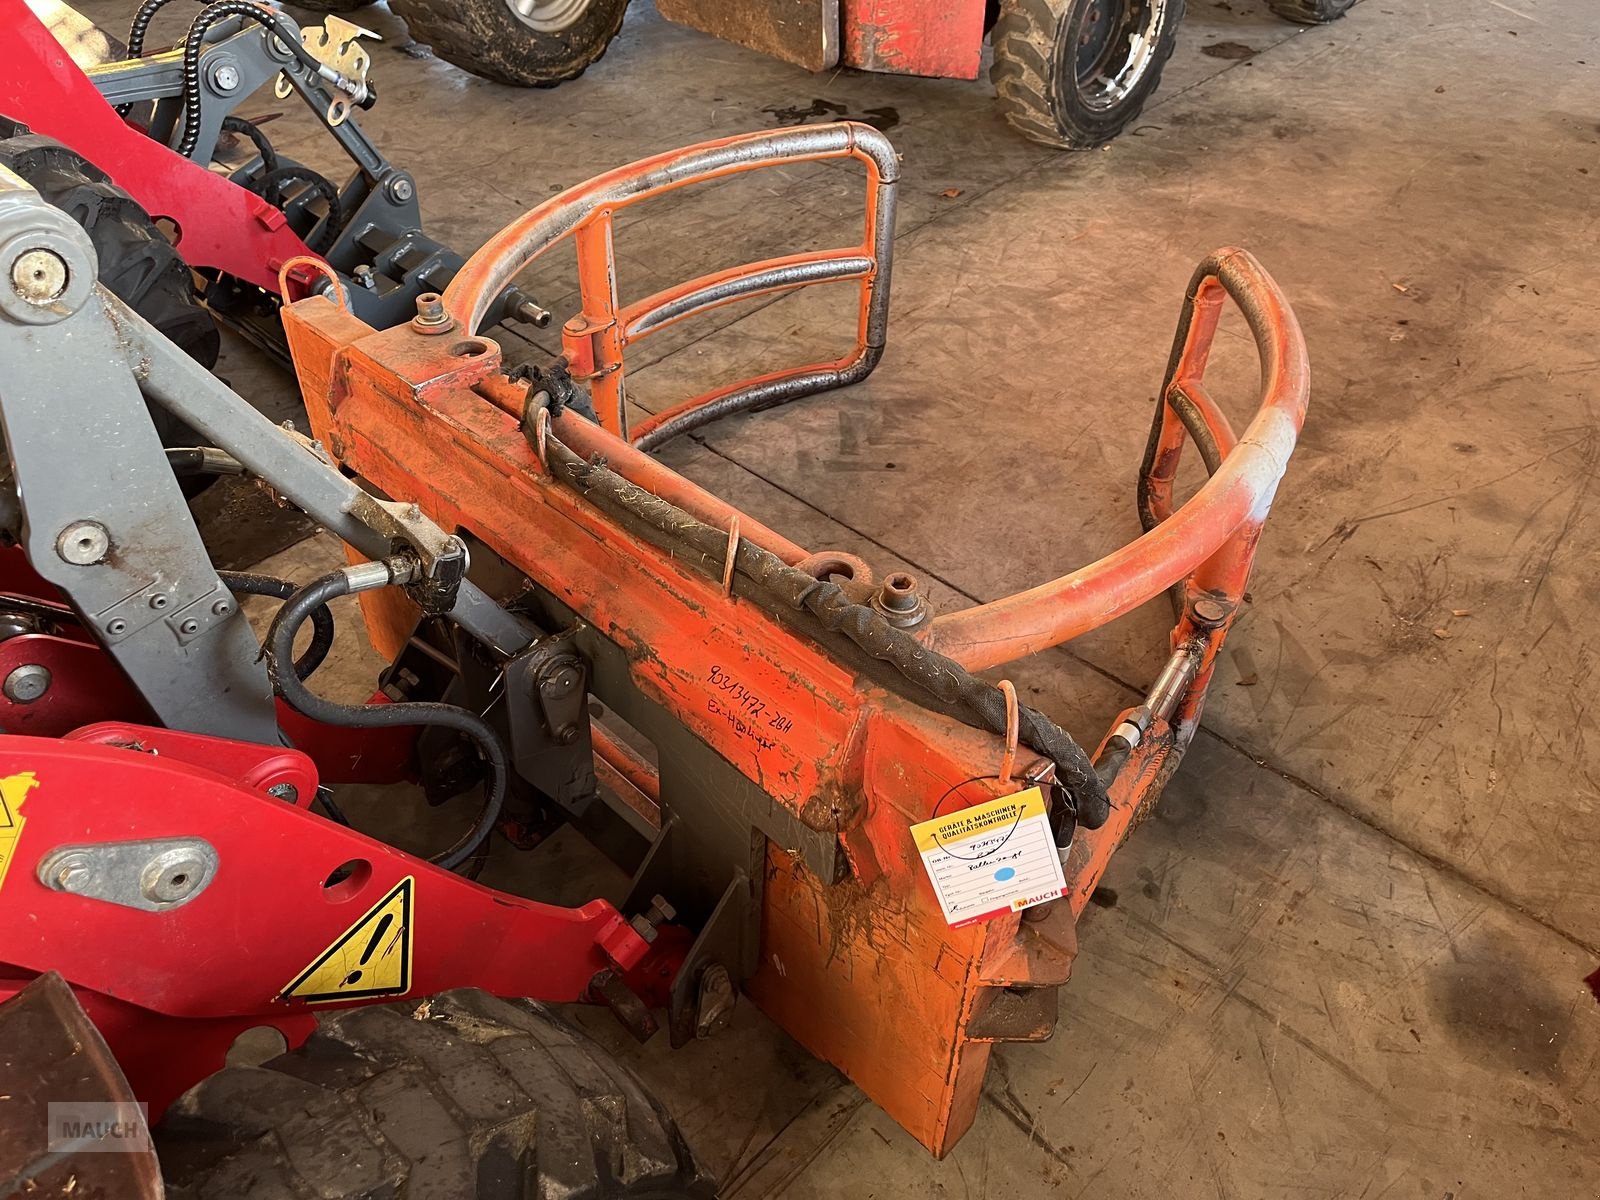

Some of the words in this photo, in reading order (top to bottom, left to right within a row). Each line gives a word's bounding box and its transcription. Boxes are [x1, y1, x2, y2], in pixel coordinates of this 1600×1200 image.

[938, 822, 965, 834] GERÄTE
[966, 817, 973, 826] &
[973, 803, 1017, 823] MASCHINEN
[942, 811, 1018, 840] QUALITÄTSKONTROLLE
[1017, 890, 1059, 908] MAUCH
